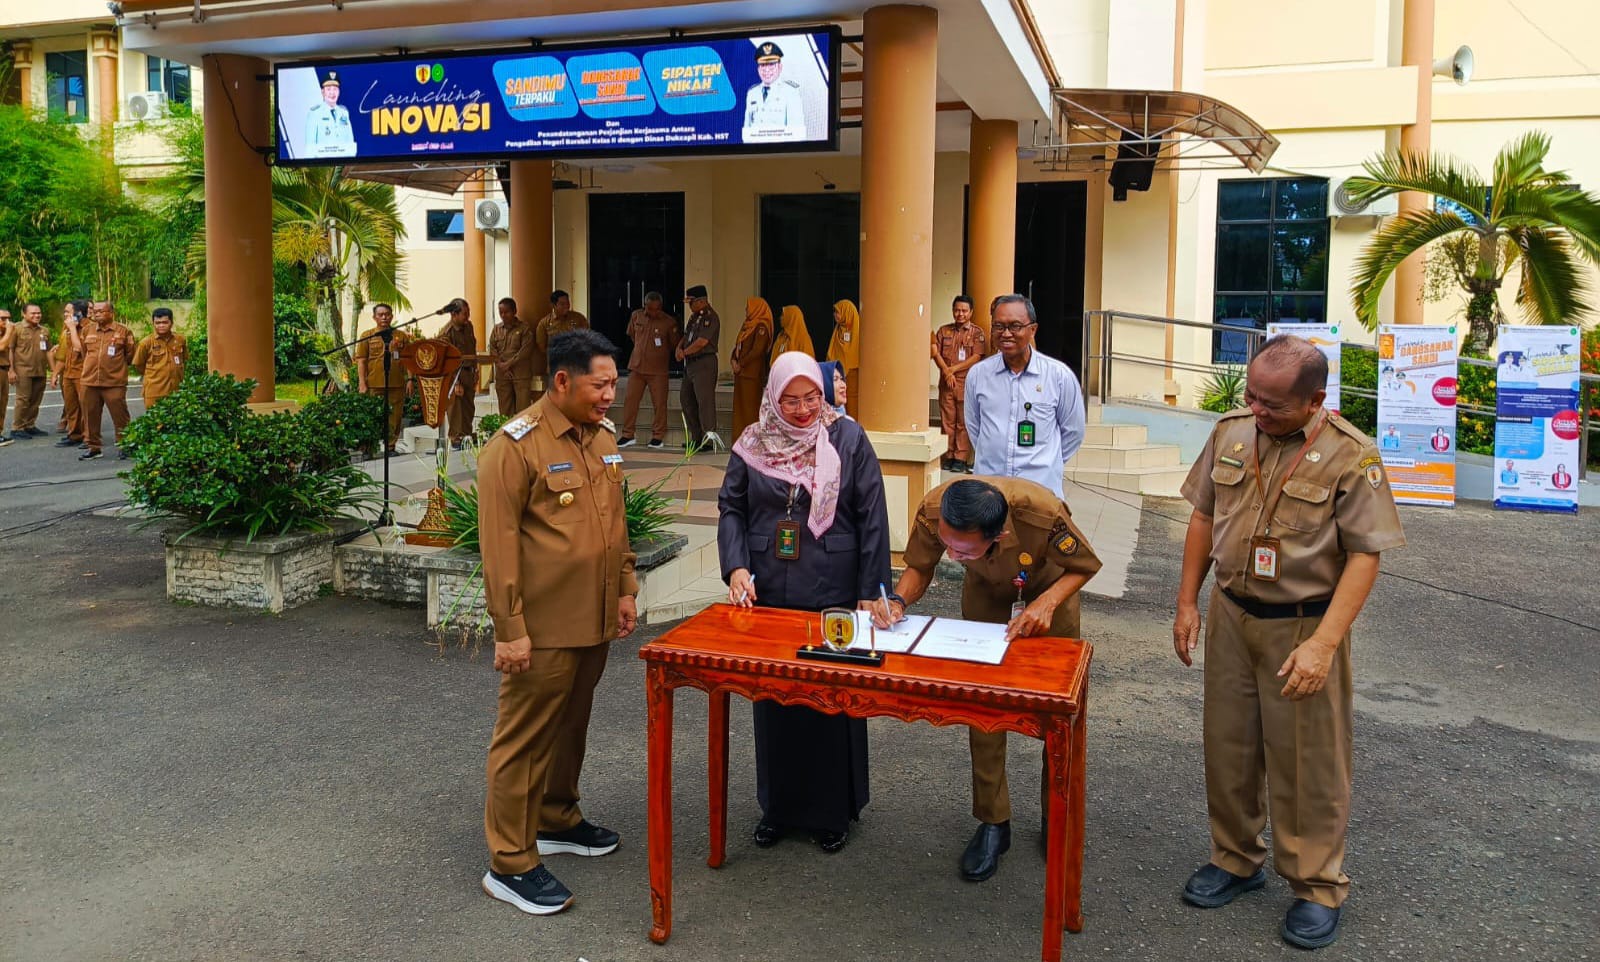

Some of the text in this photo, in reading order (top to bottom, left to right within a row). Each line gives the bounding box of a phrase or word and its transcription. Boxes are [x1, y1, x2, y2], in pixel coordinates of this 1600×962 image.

[661, 63, 722, 80] SIPATEN
[505, 73, 567, 95] SANDIMU
[667, 77, 712, 93] NIKAH
[359, 78, 486, 128] Launching
[514, 91, 556, 105] TERPAKU
[371, 102, 490, 136] INOVASI
[598, 127, 633, 136] Perjanjian
[633, 126, 670, 135] Kerjasama
[505, 140, 542, 148] Pengadilan
[542, 138, 565, 147] Negeri
[592, 136, 611, 144] Kelas
[617, 136, 643, 144] dengan
[665, 134, 697, 142] Dukcapil
[714, 132, 730, 140] HST
